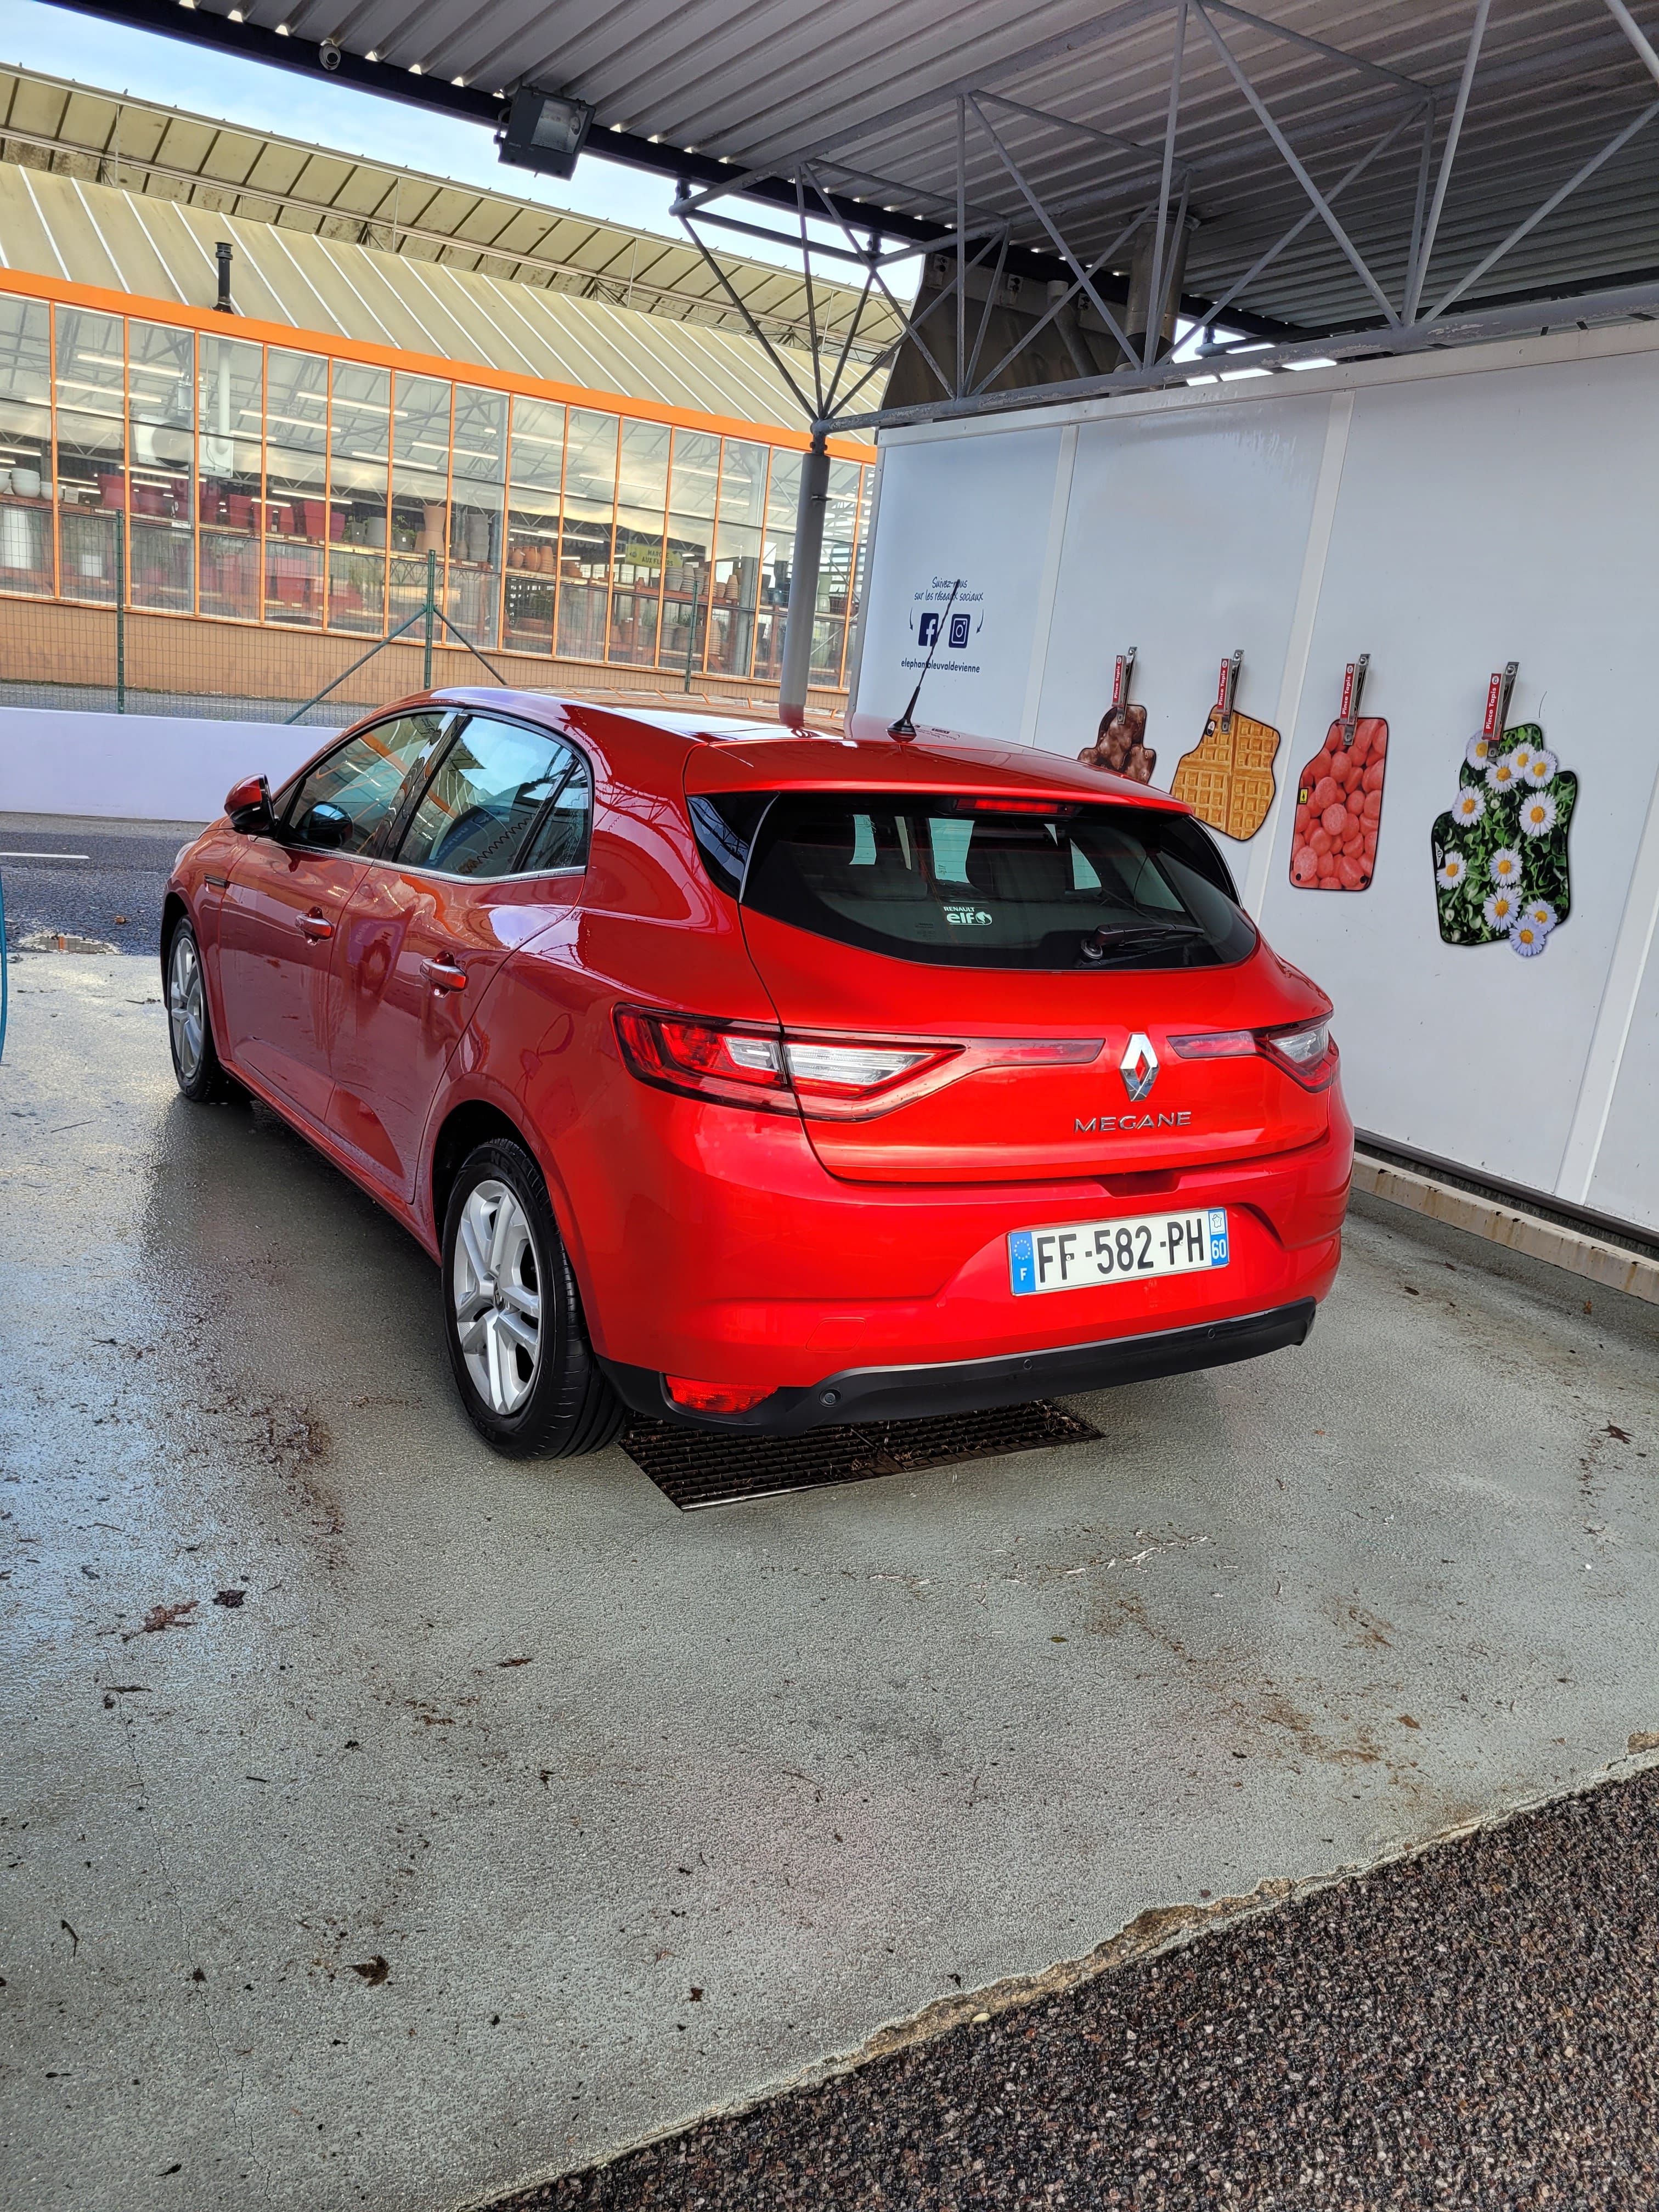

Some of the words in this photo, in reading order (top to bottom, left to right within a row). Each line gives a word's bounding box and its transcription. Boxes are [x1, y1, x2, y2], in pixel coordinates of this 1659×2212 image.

[648, 550, 669, 558] MARCE
[653, 558, 674, 566] FLRS
[914, 592, 924, 601] sur
[926, 589, 934, 601] les
[960, 591, 984, 602] sociaux
[946, 912, 975, 924] elf
[1074, 1111, 1192, 1133] MEGANE
[1036, 1218, 1204, 1283] FF-582-PH
[1211, 1239, 1227, 1260] 60
[1020, 1267, 1028, 1281] F
